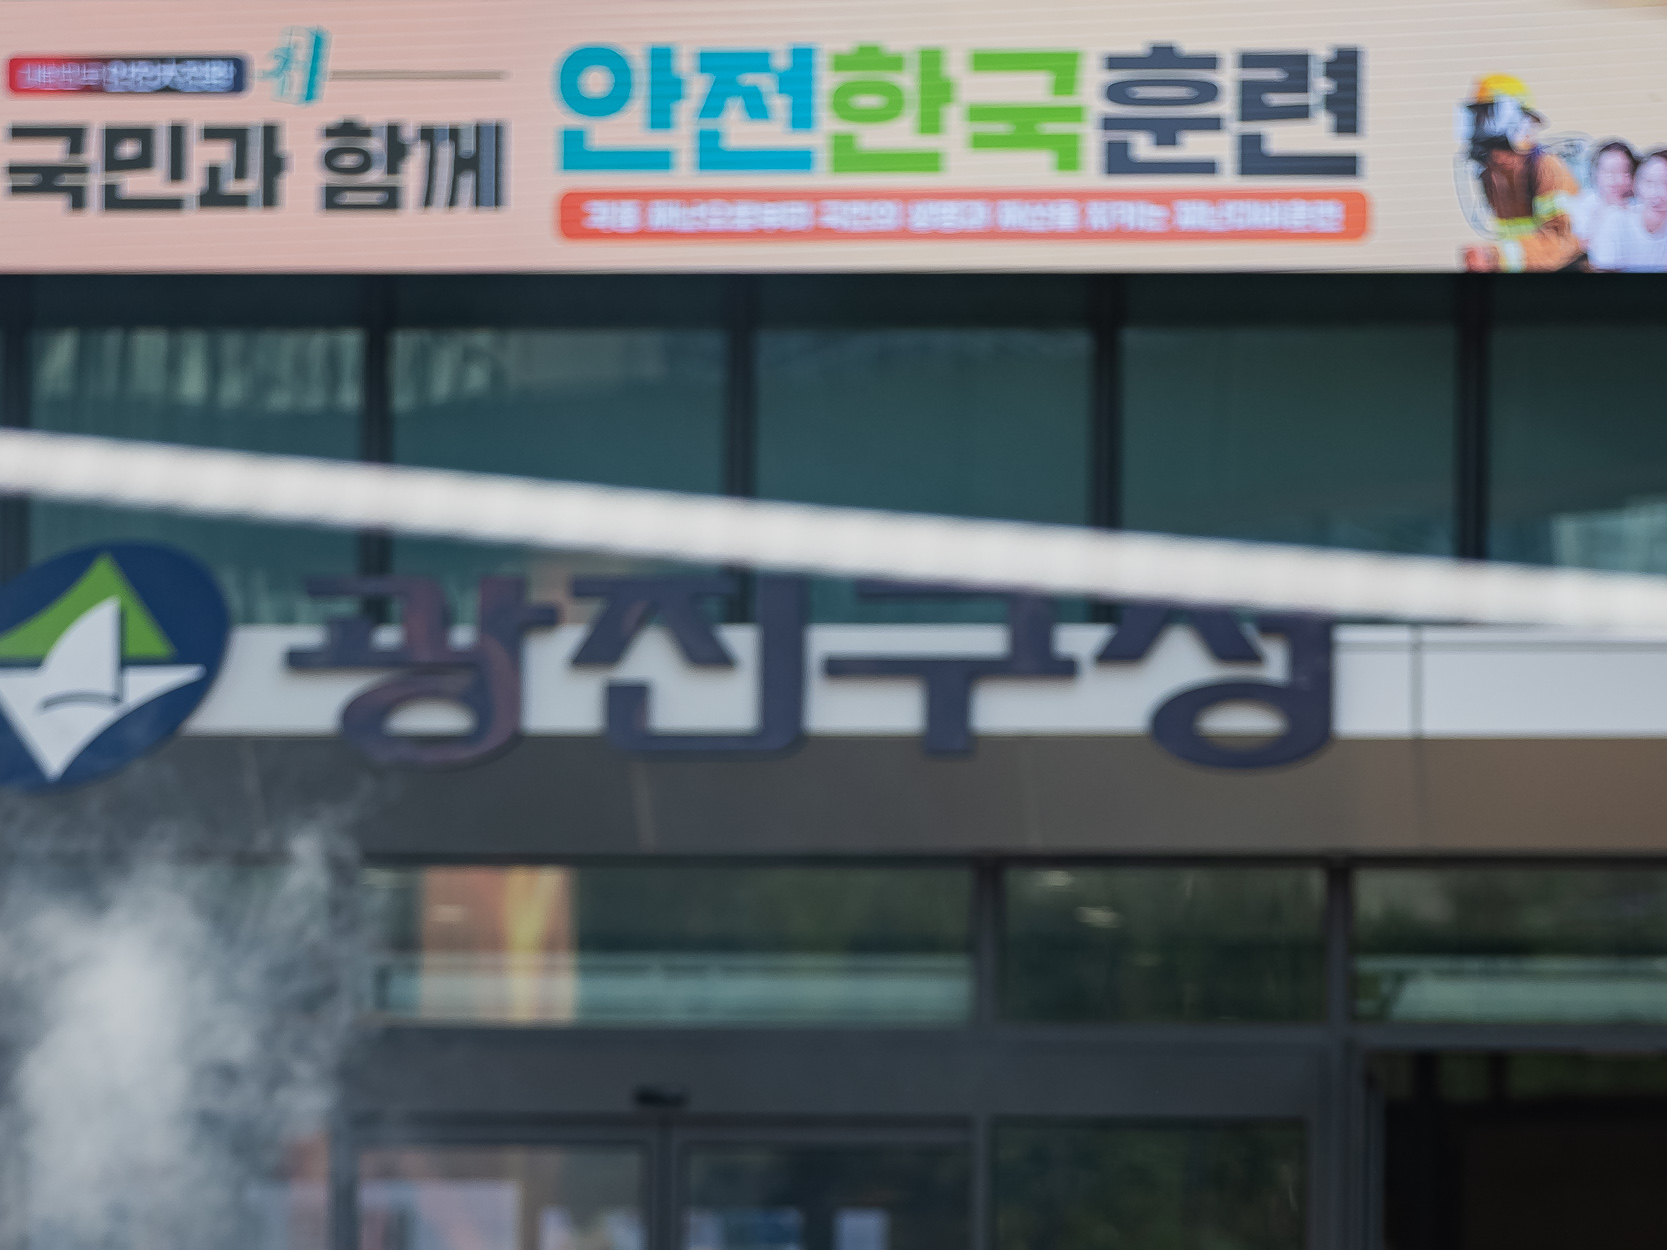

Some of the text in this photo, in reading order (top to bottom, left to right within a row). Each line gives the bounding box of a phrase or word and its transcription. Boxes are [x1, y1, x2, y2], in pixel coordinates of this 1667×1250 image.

[5, 118, 508, 212] 국민과 함께
[556, 44, 1364, 175] 안전한국훈련
